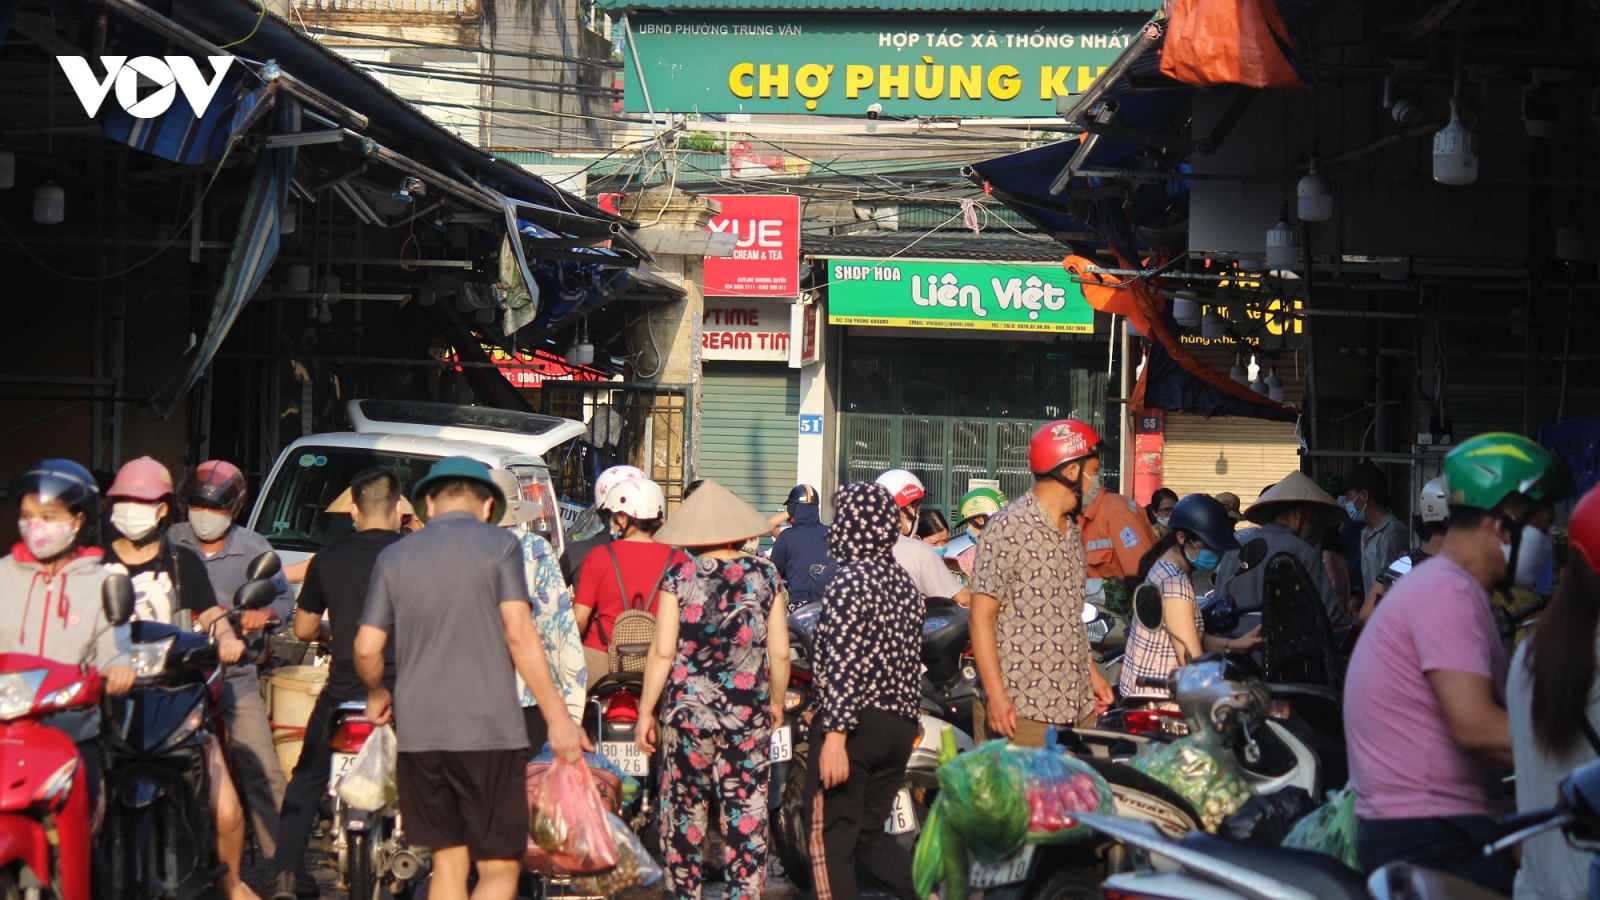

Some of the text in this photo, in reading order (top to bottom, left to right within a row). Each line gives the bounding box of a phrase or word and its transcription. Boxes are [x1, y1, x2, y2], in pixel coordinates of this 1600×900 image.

[639, 22, 802, 35] UBND PHƯỜNG TRUNG VĂN
[878, 25, 1132, 51] HỢP TÁC XÃ THỐNG NHẤT
[728, 61, 834, 109] CHỢ
[846, 55, 1021, 100] PHÙNG
[733, 250, 759, 260] CREAM
[761, 251, 767, 260] &
[768, 250, 783, 260] TEA
[834, 265, 901, 281] SHOP HOA
[911, 271, 1066, 321] Liên Việt
[1178, 334, 1211, 346] hùng
[1143, 418, 1156, 429] 55
